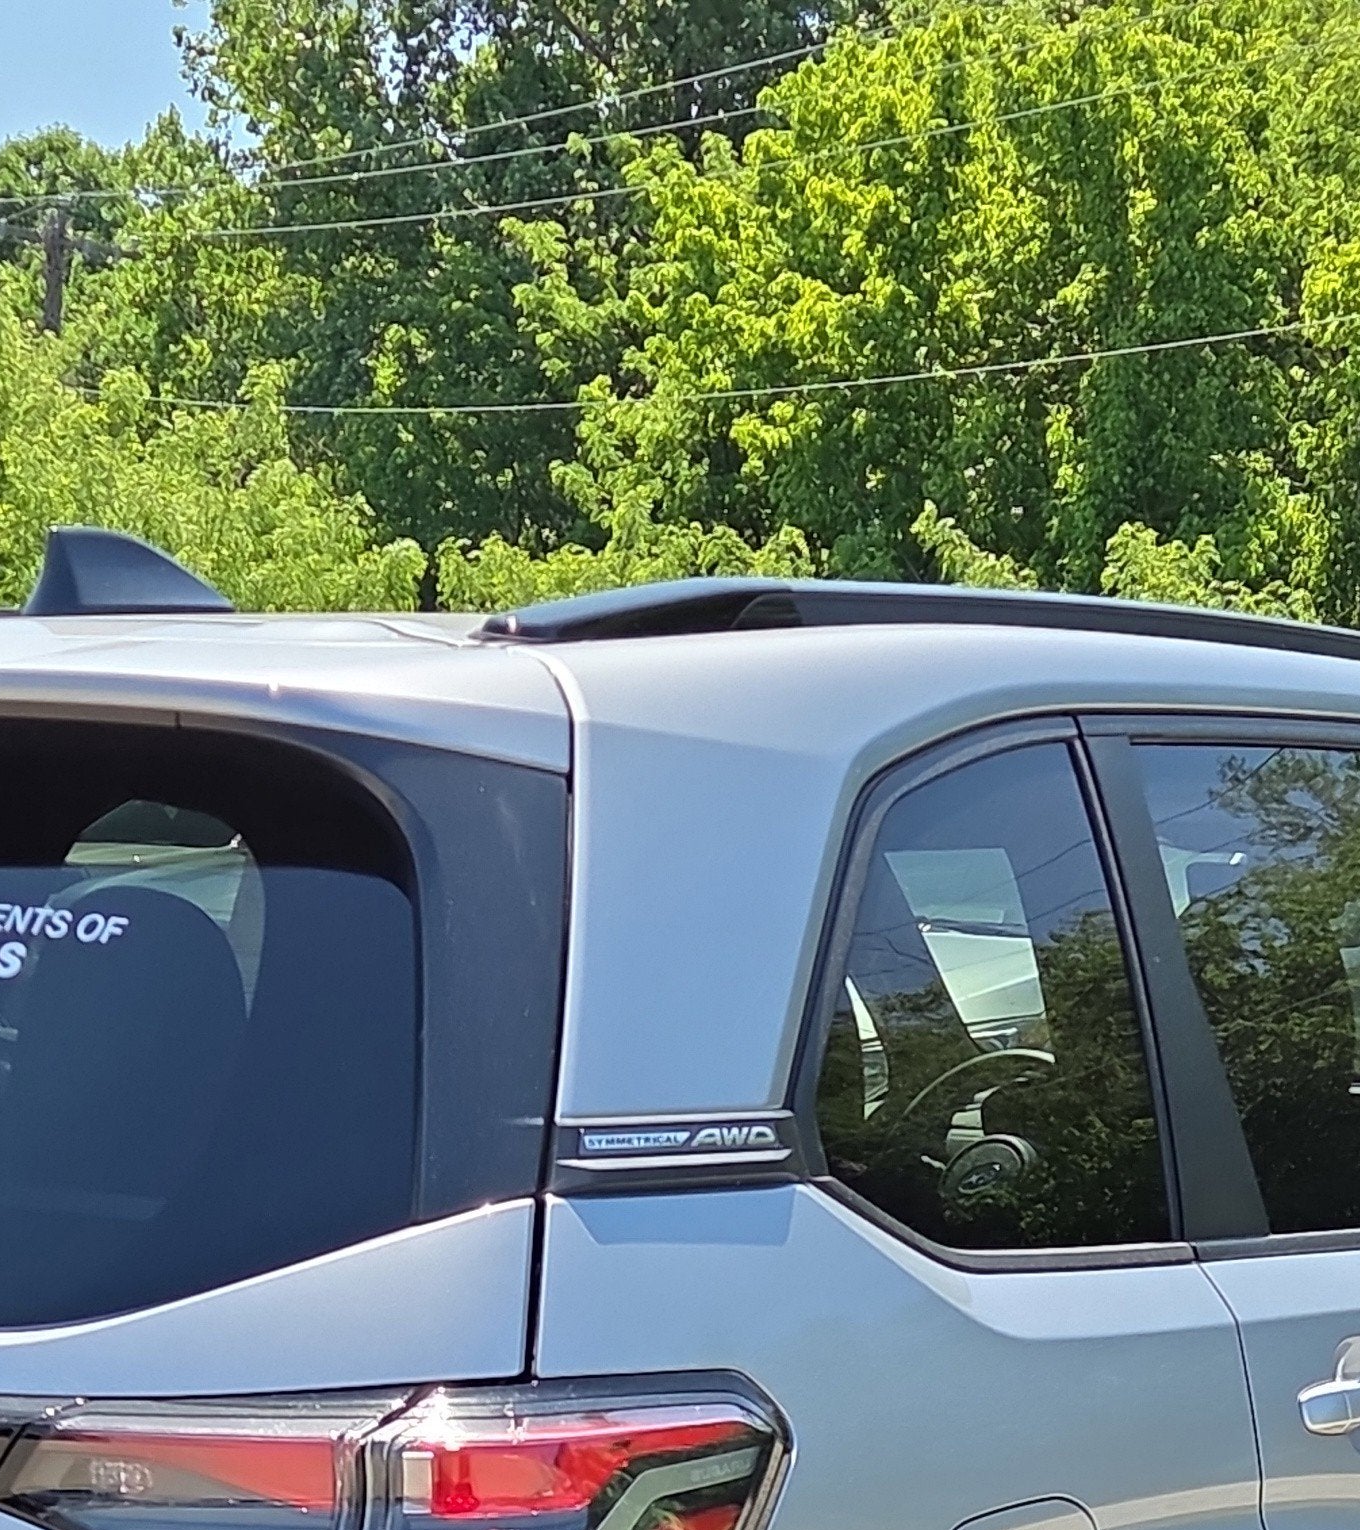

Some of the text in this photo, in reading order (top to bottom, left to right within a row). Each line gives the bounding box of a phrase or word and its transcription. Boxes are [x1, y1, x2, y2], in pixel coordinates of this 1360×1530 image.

[75, 913, 130, 944] OF
[587, 1126, 778, 1149] SYMMETRICAL AWD
